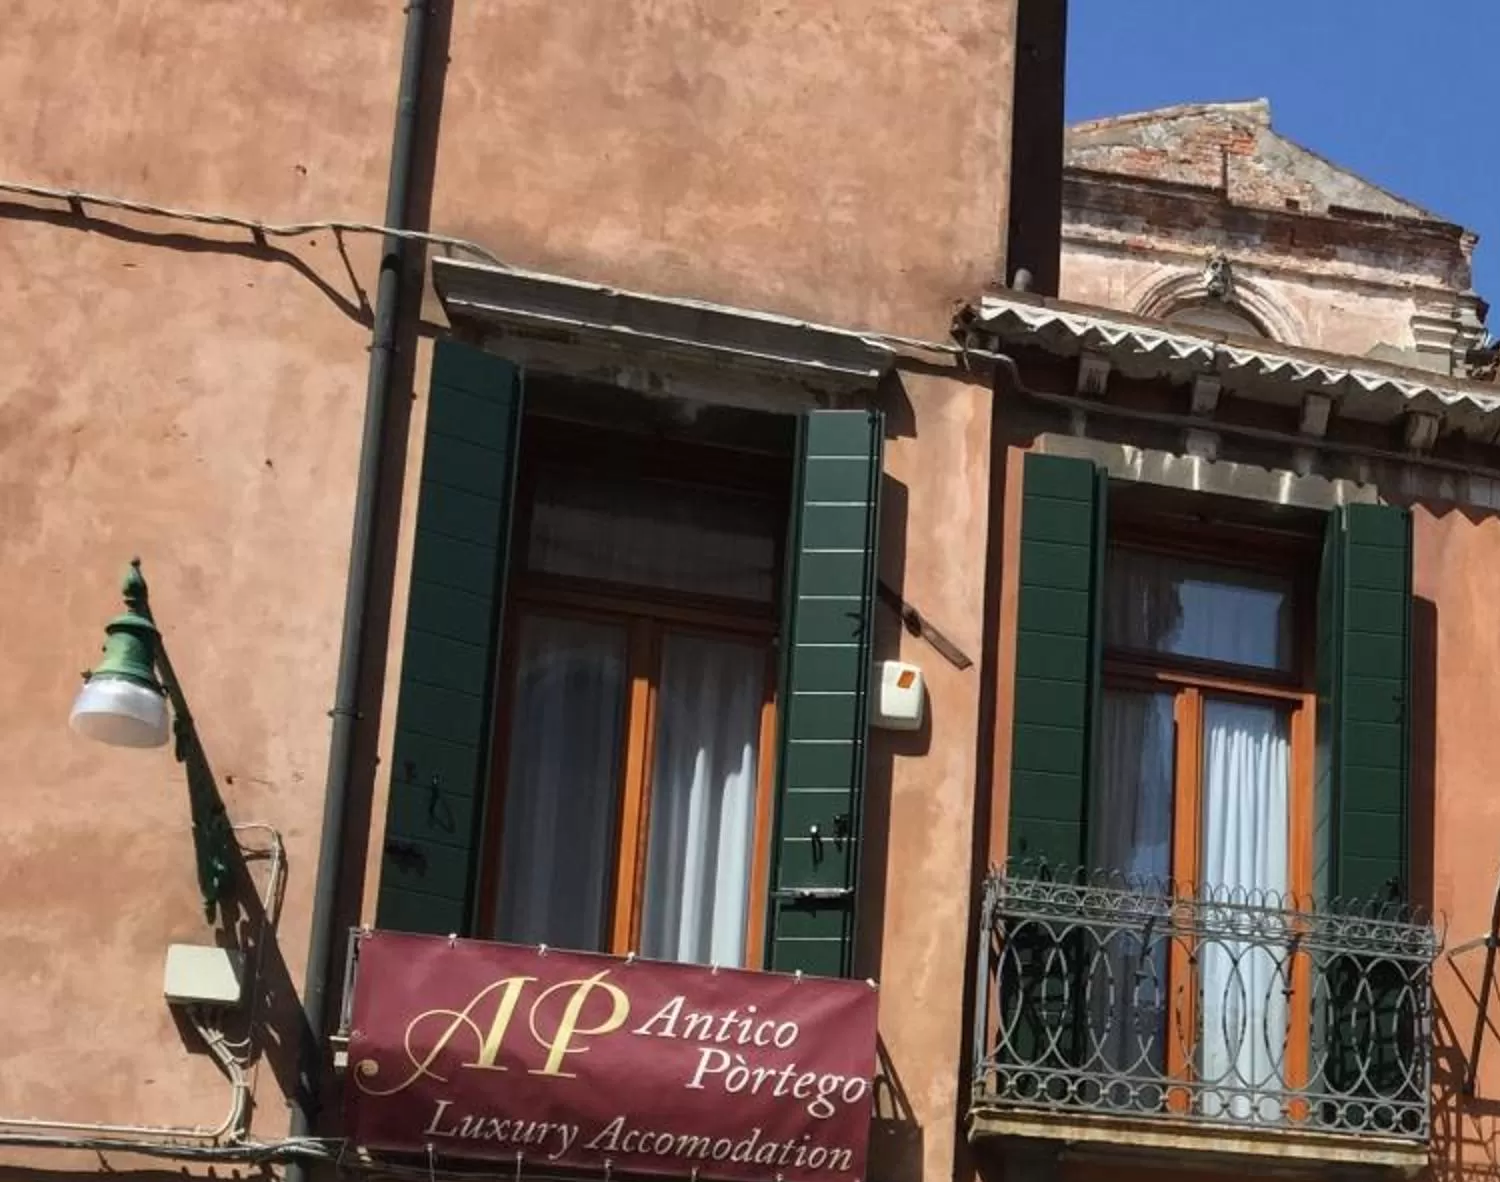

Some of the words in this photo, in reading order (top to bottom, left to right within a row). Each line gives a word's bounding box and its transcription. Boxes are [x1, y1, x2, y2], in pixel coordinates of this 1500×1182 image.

[354, 969, 631, 1095] AP
[632, 995, 800, 1049] Antico
[685, 1047, 869, 1119] Pòrtego
[424, 1100, 580, 1161] Luxury
[585, 1115, 854, 1172] Accomodation
